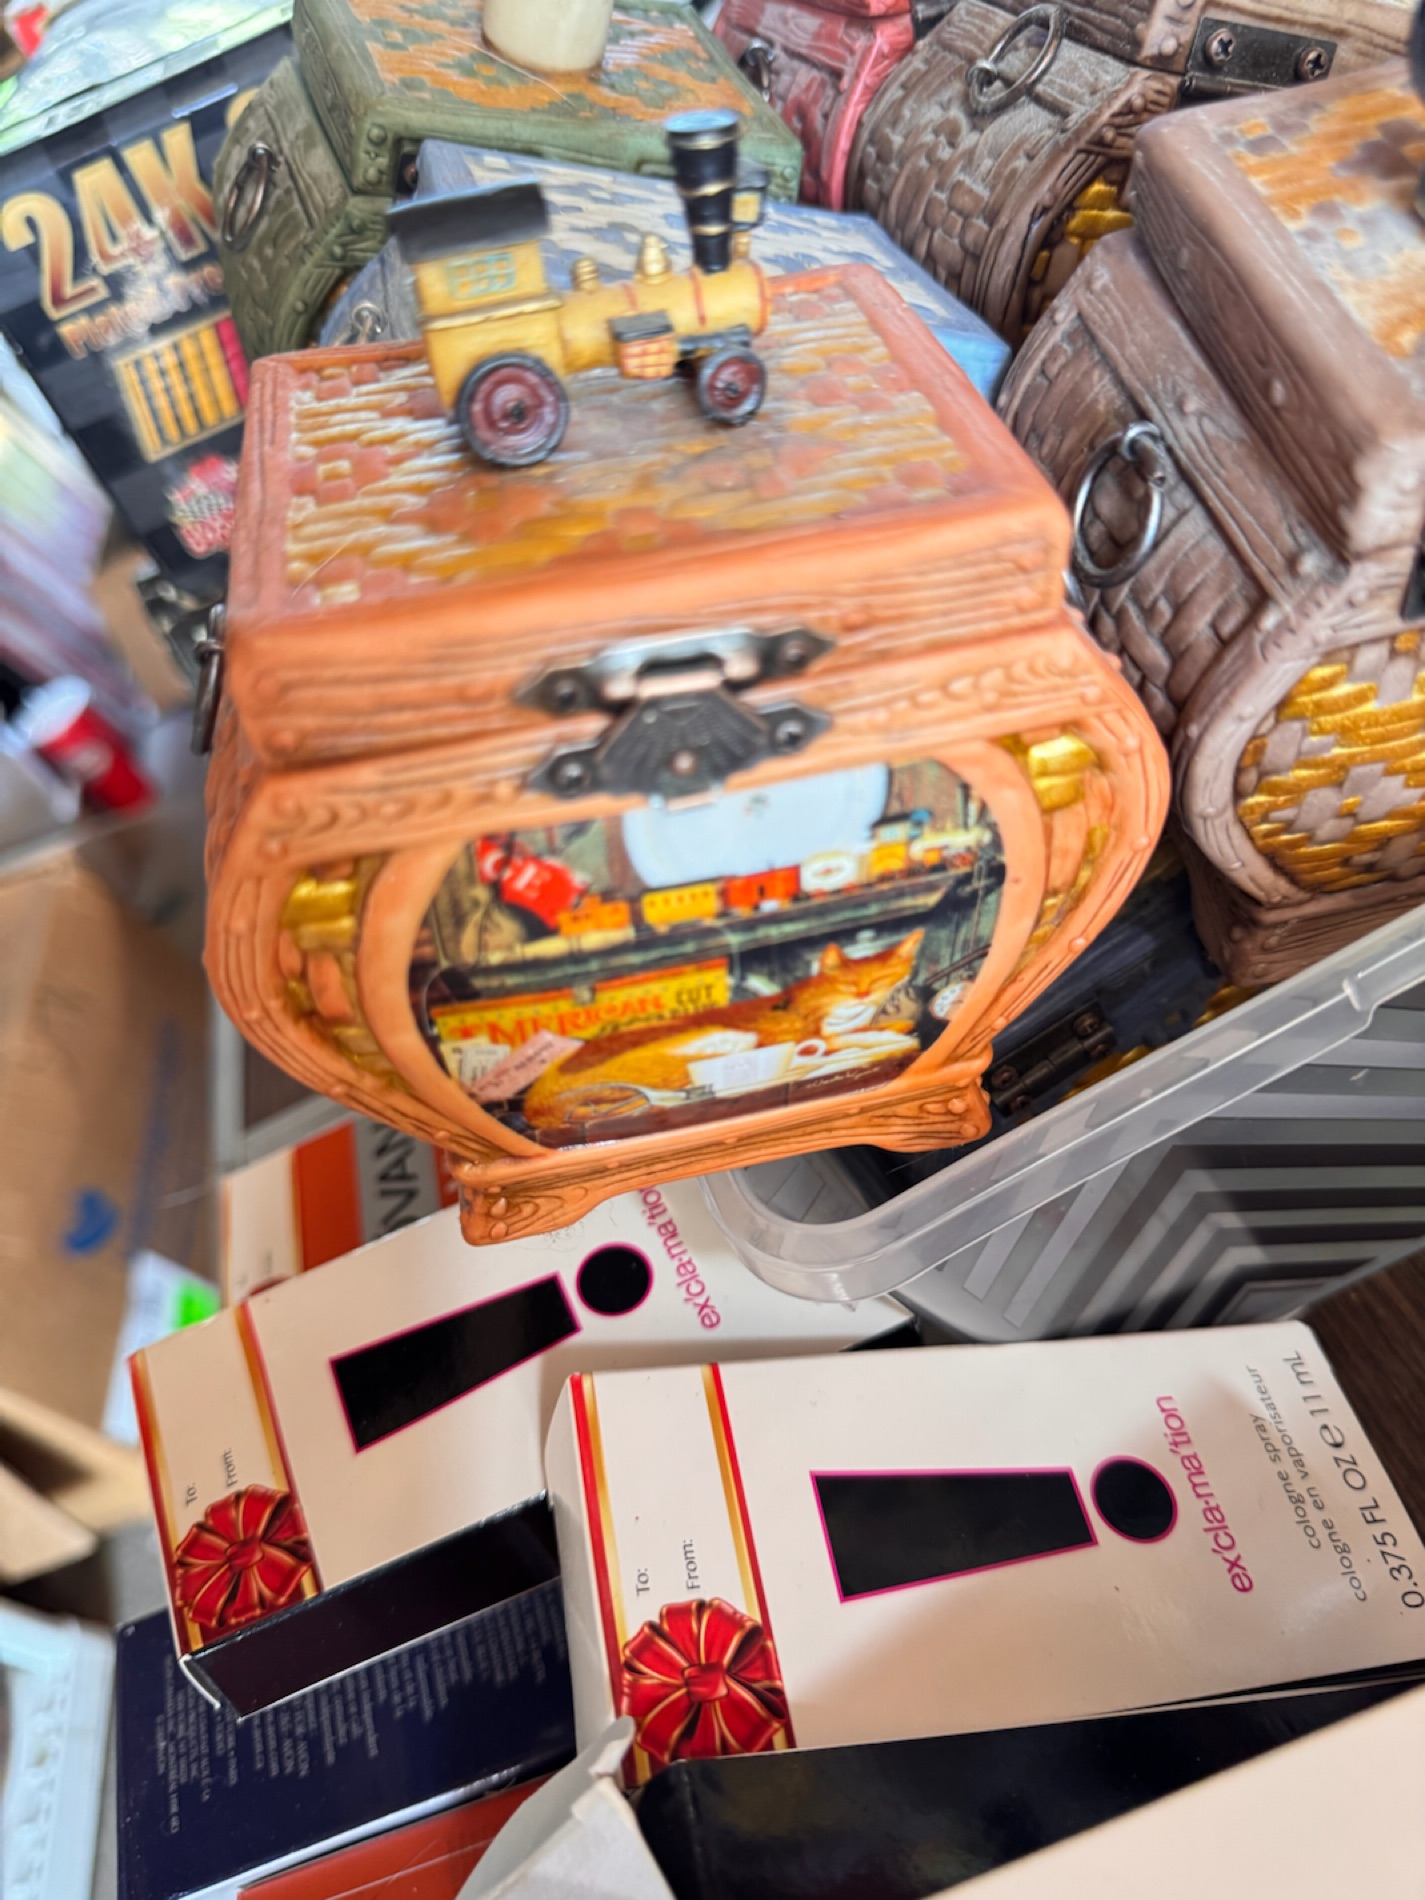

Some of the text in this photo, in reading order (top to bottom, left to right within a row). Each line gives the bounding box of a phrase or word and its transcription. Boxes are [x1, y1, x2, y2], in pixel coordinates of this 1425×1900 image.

[1, 120, 217, 321] 24K
[1281, 1349, 1315, 1386] mL
[222, 1447, 239, 1489] From:
[1245, 1364, 1368, 1602] cologne en vaporisateur
[1249, 1411, 1322, 1550] cologne spray
[1331, 1453, 1367, 1492] OZ
[1358, 1495, 1387, 1526] FL
[635, 1568, 650, 1597] To:
[682, 1539, 701, 1590] From:
[1371, 1531, 1425, 1609] 0.375
